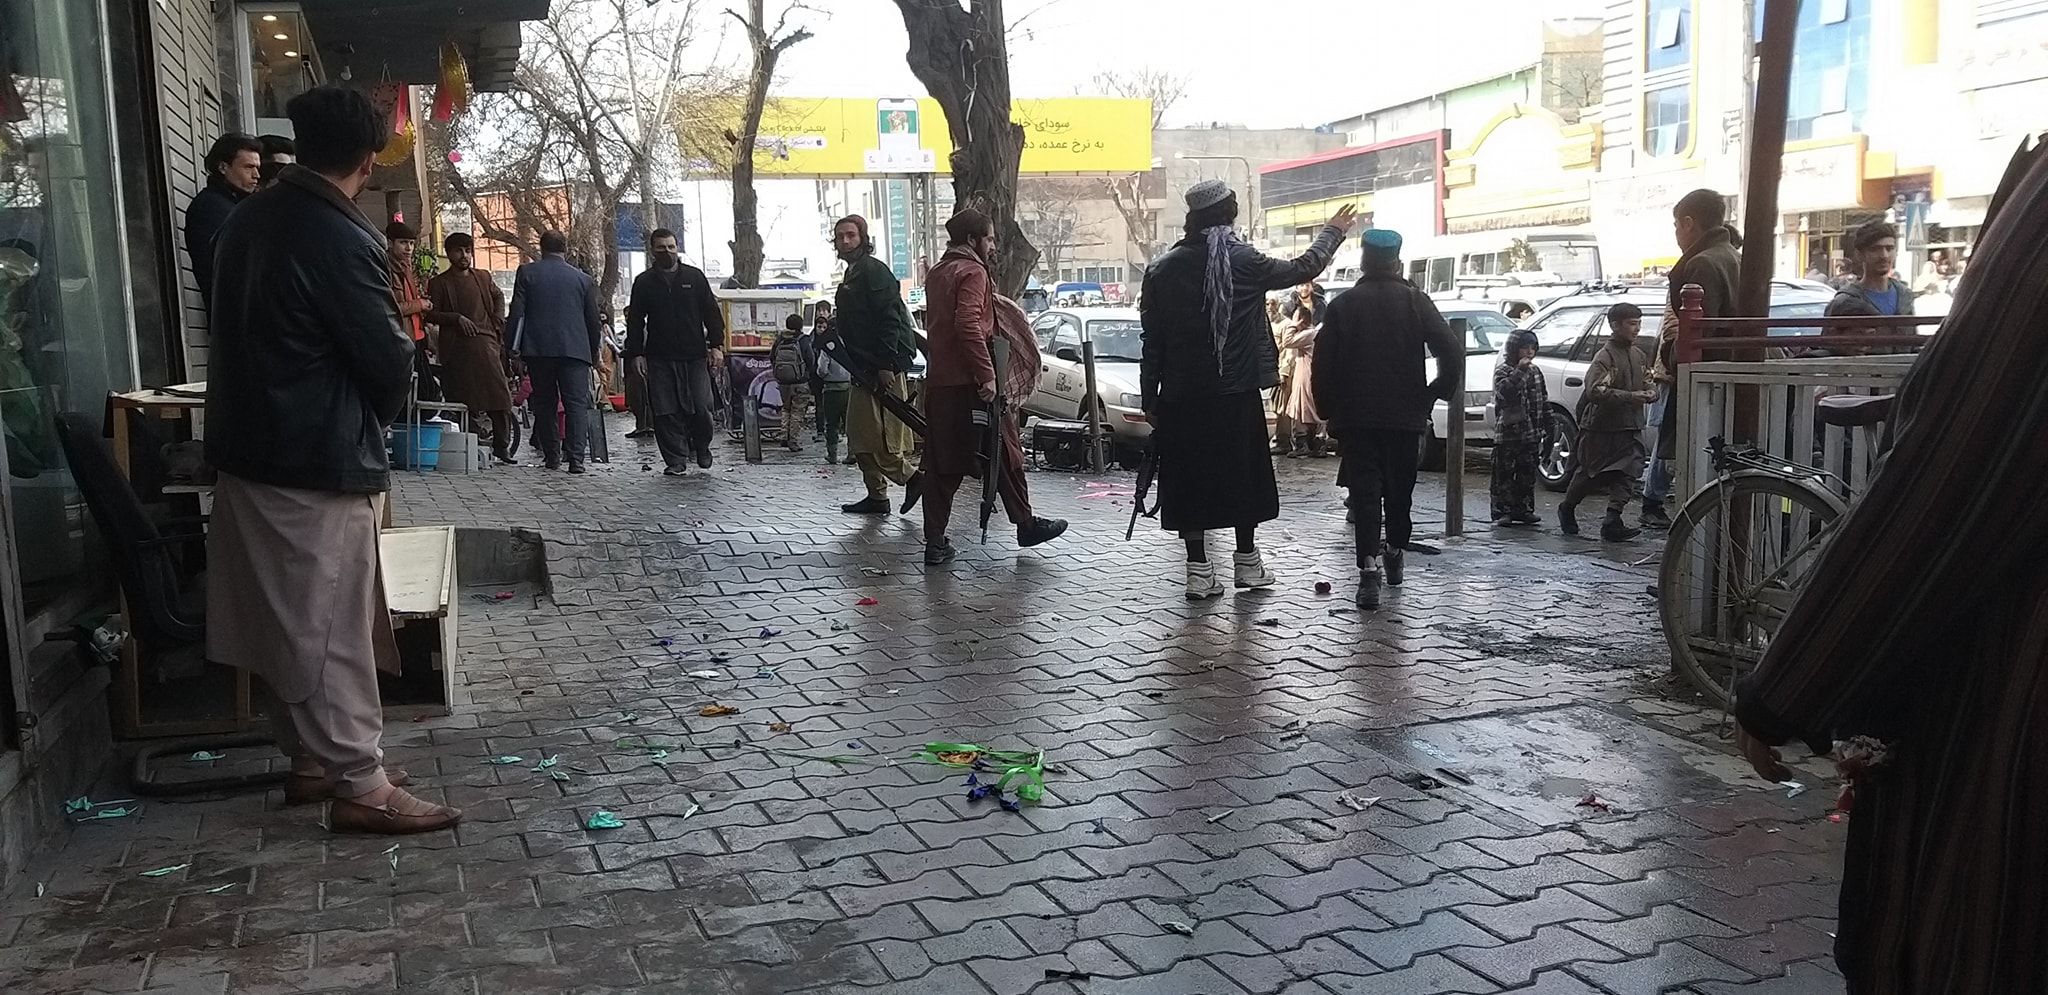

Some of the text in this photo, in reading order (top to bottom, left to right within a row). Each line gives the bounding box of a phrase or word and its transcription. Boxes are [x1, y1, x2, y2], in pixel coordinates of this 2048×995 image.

[1035, 118, 1070, 132] سودای
[1071, 139, 1091, 153] نرخ
[1094, 140, 1104, 151] به
